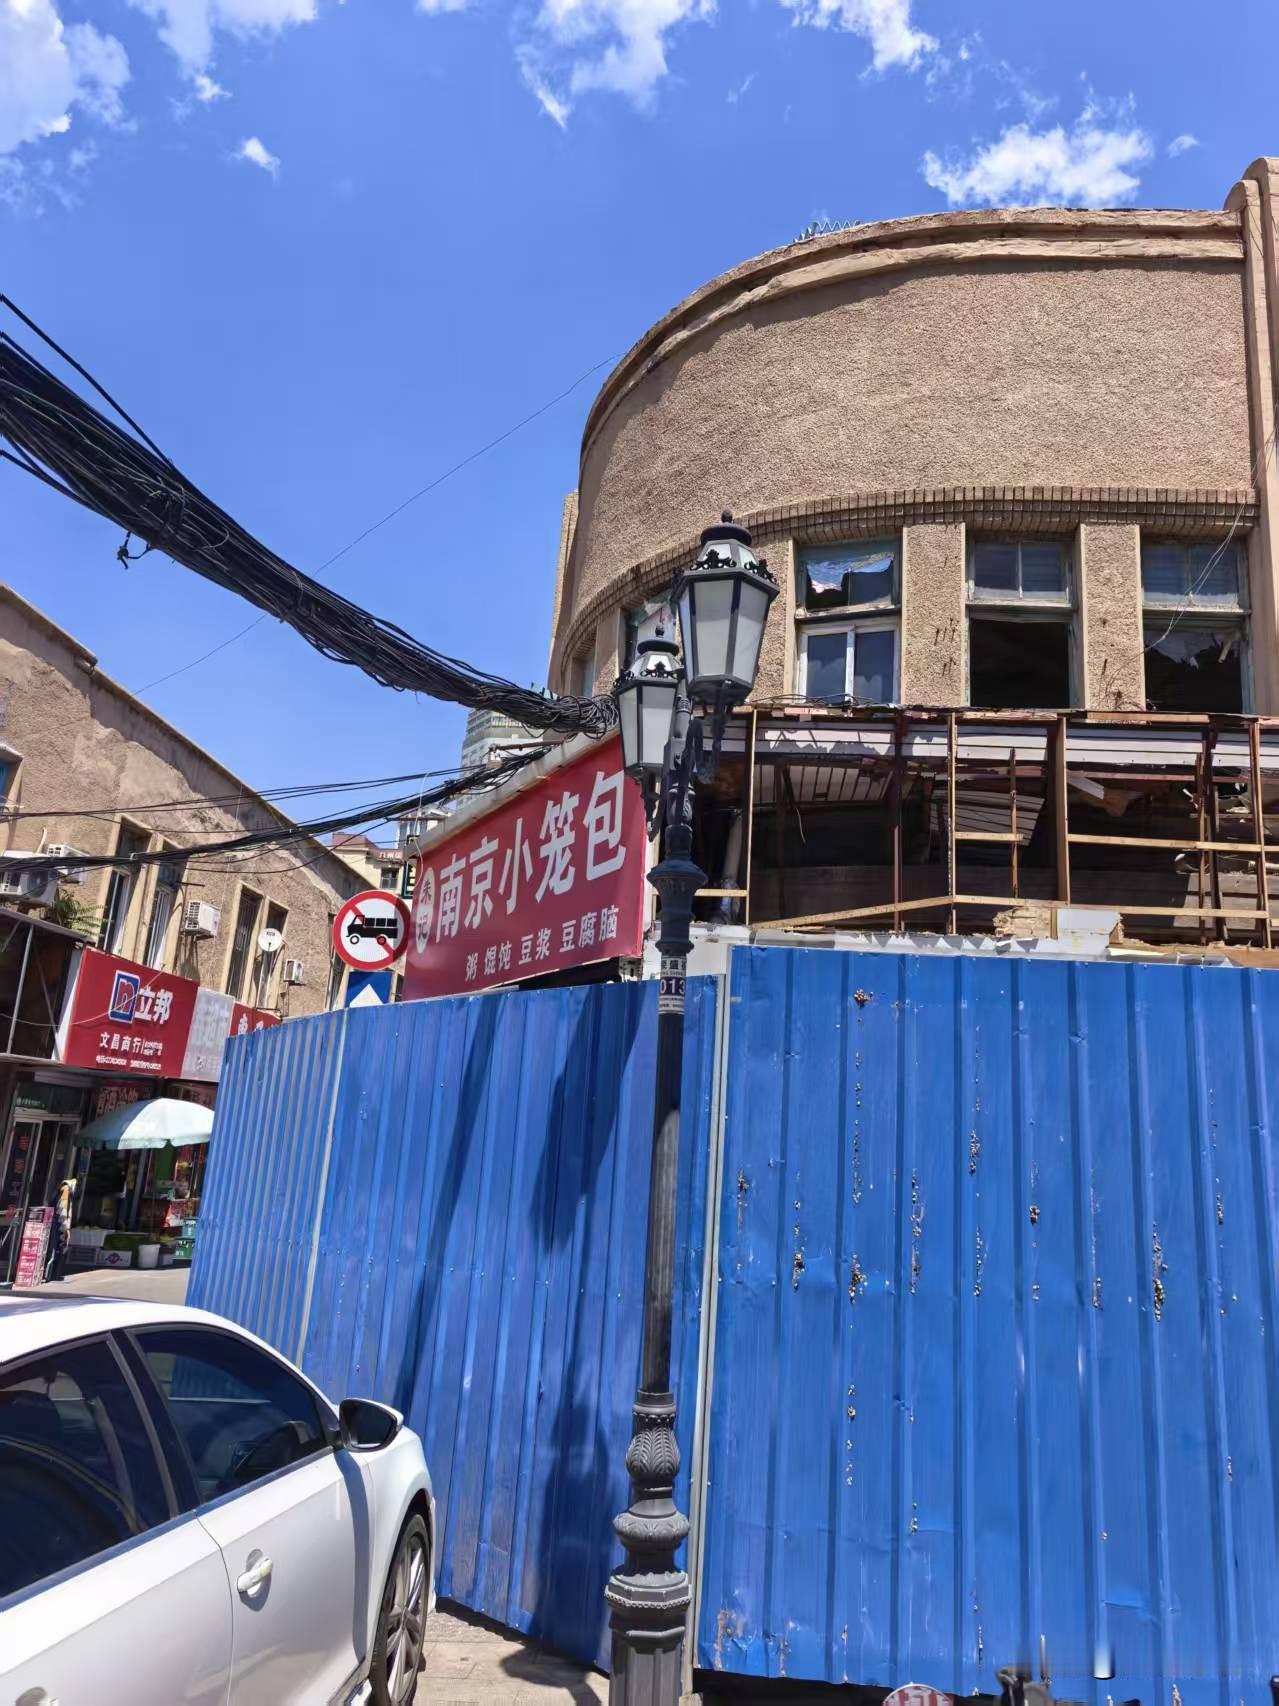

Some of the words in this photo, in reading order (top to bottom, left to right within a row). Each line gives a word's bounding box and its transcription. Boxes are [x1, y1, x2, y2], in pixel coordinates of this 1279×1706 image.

[435, 770, 626, 943] 南京小笼包
[465, 952, 478, 982] 粥
[518, 927, 551, 966] 豆浆
[559, 904, 619, 953] 豆腐脑
[134, 985, 174, 1025] 立邦
[99, 1031, 142, 1054] 文昌商行
